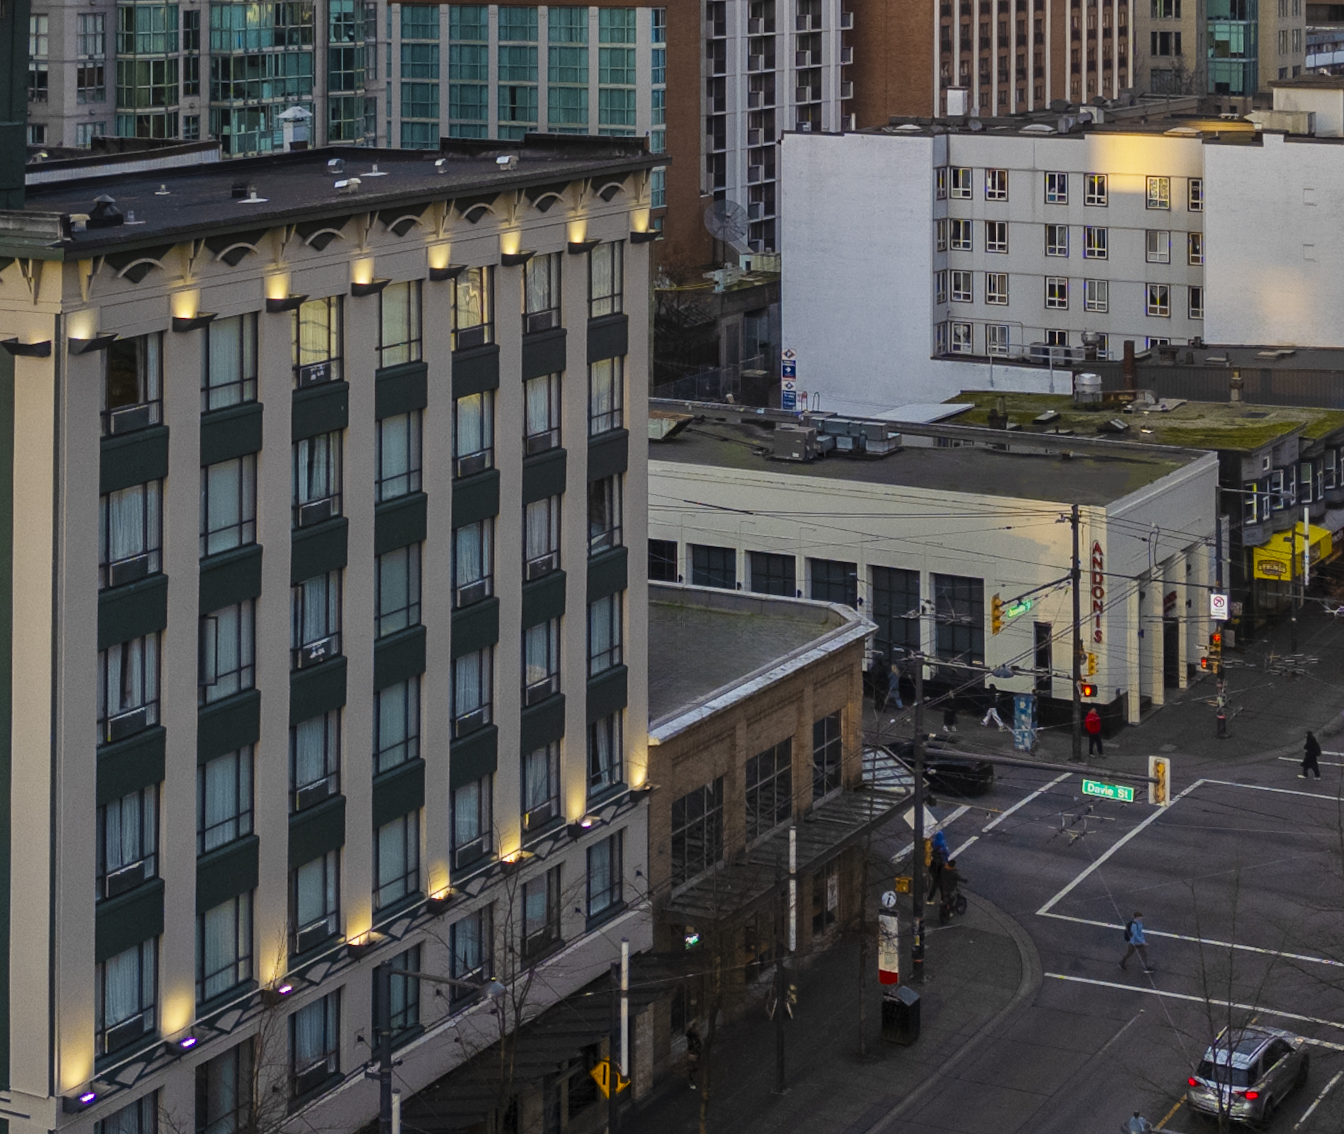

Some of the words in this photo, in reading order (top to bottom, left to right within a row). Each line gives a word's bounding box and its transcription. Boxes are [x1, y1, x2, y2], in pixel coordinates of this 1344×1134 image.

[1091, 541, 1105, 644] ANDONIS
[1087, 783, 1114, 796] Davie
[1117, 788, 1129, 799] St
